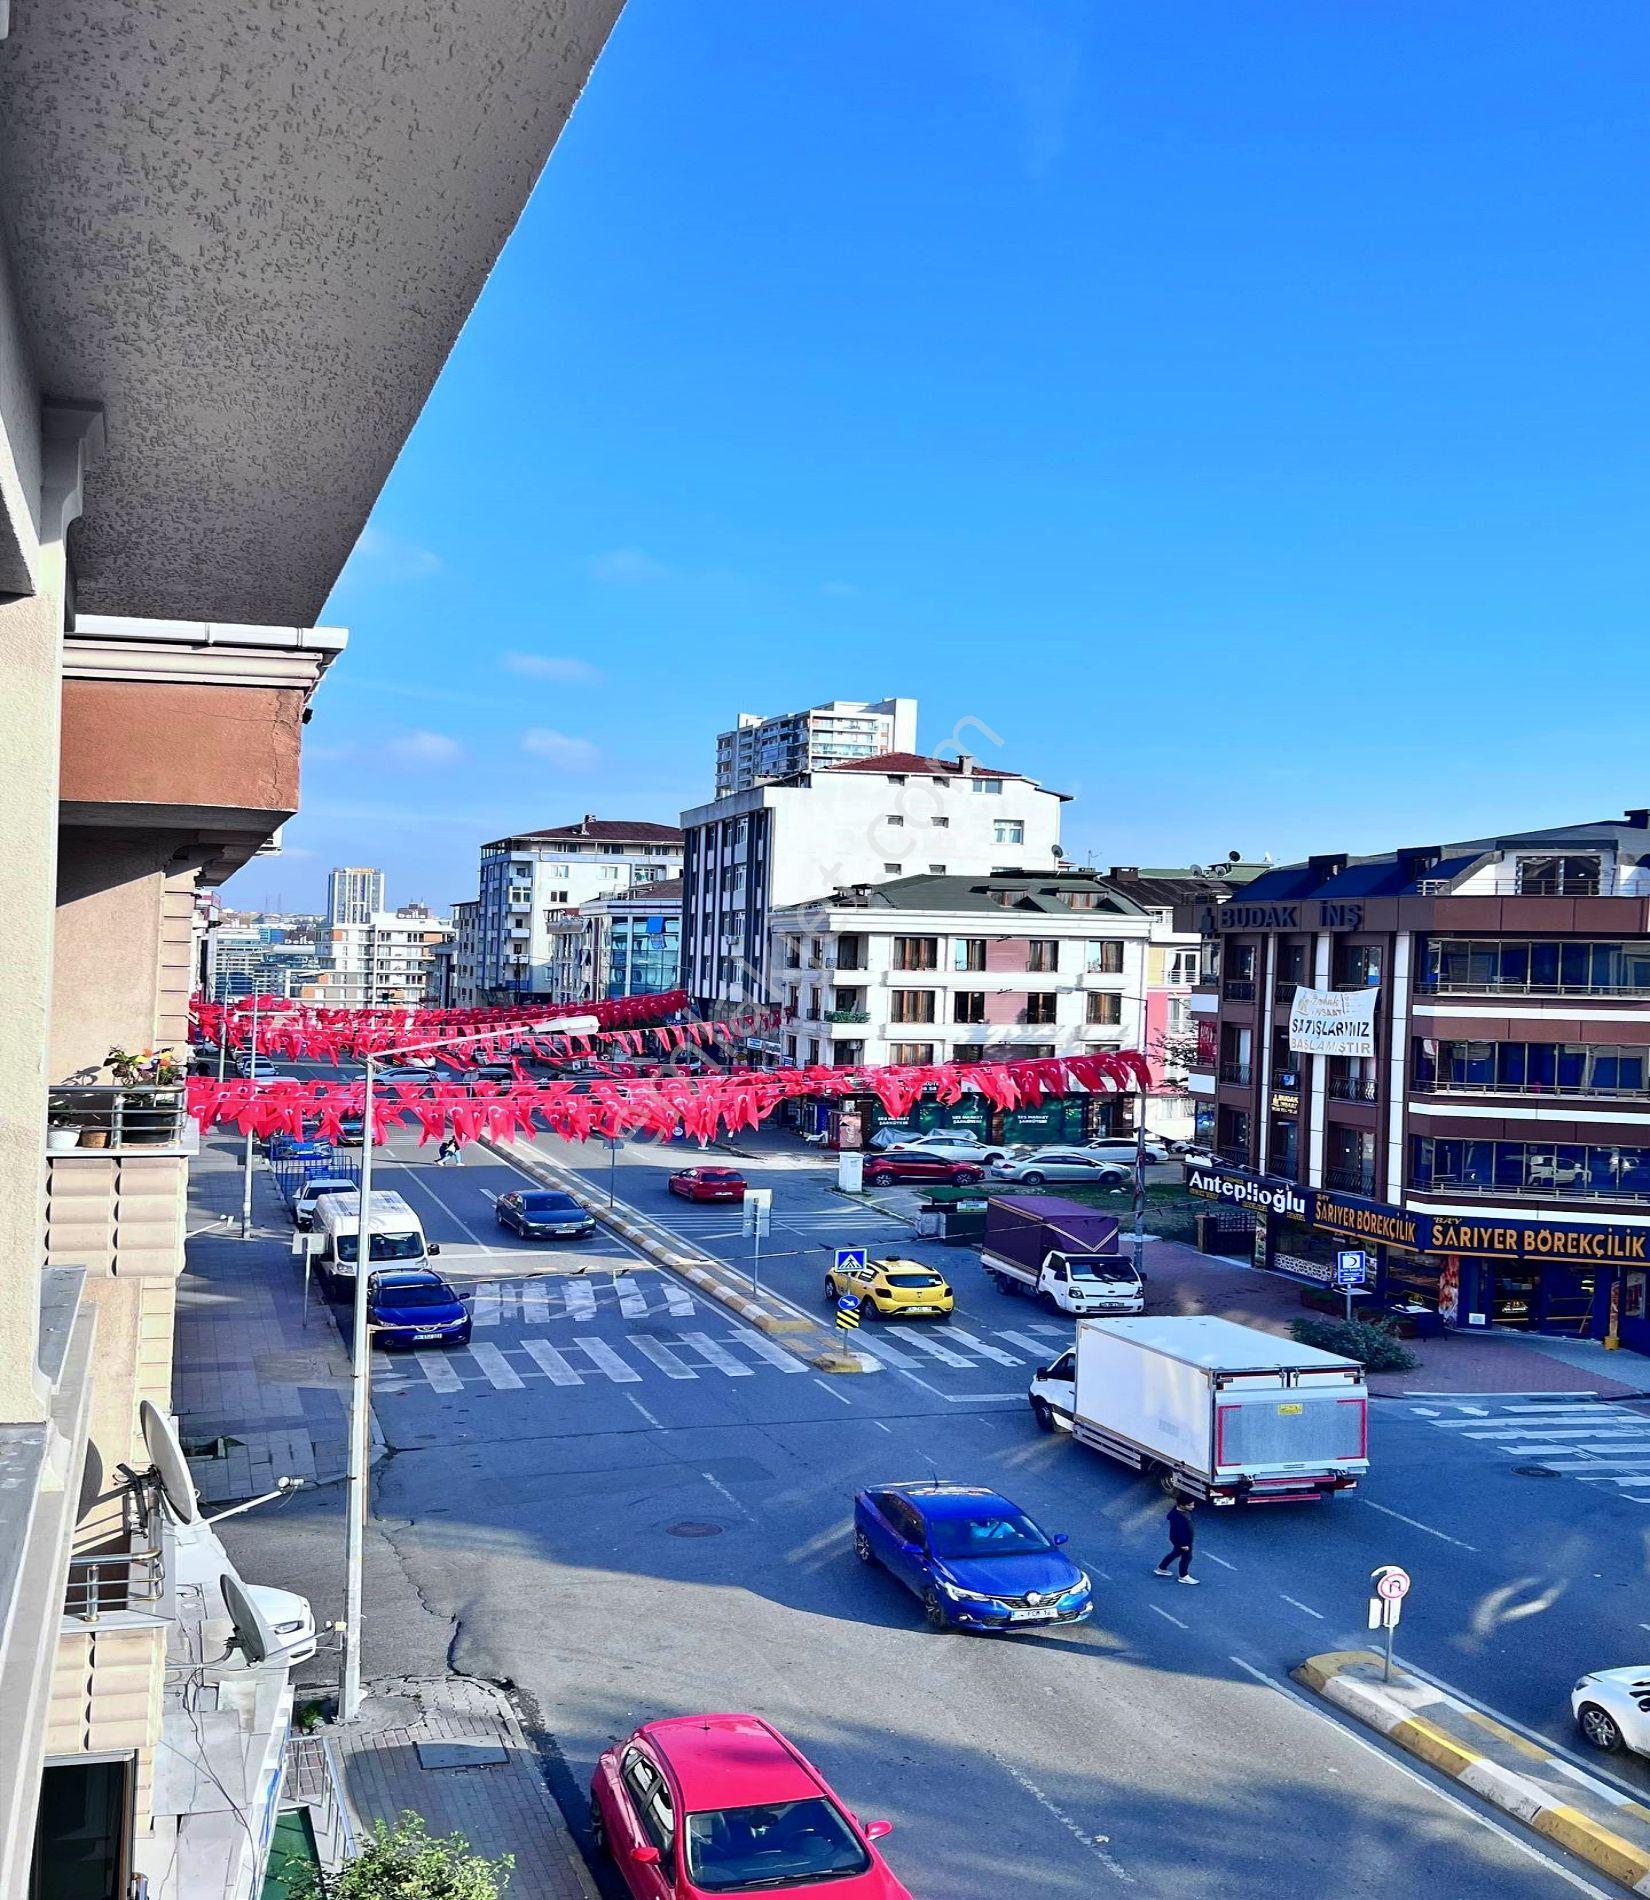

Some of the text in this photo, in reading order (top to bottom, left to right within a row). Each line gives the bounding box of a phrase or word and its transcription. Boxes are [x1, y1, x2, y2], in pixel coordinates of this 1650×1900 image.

[1221, 906, 1298, 928] BUDAK
[1315, 1200, 1416, 1243] SARIYER BÖREKÇİLİK
[1432, 1224, 1647, 1258] SARIYER BÖREKÇİLİK
